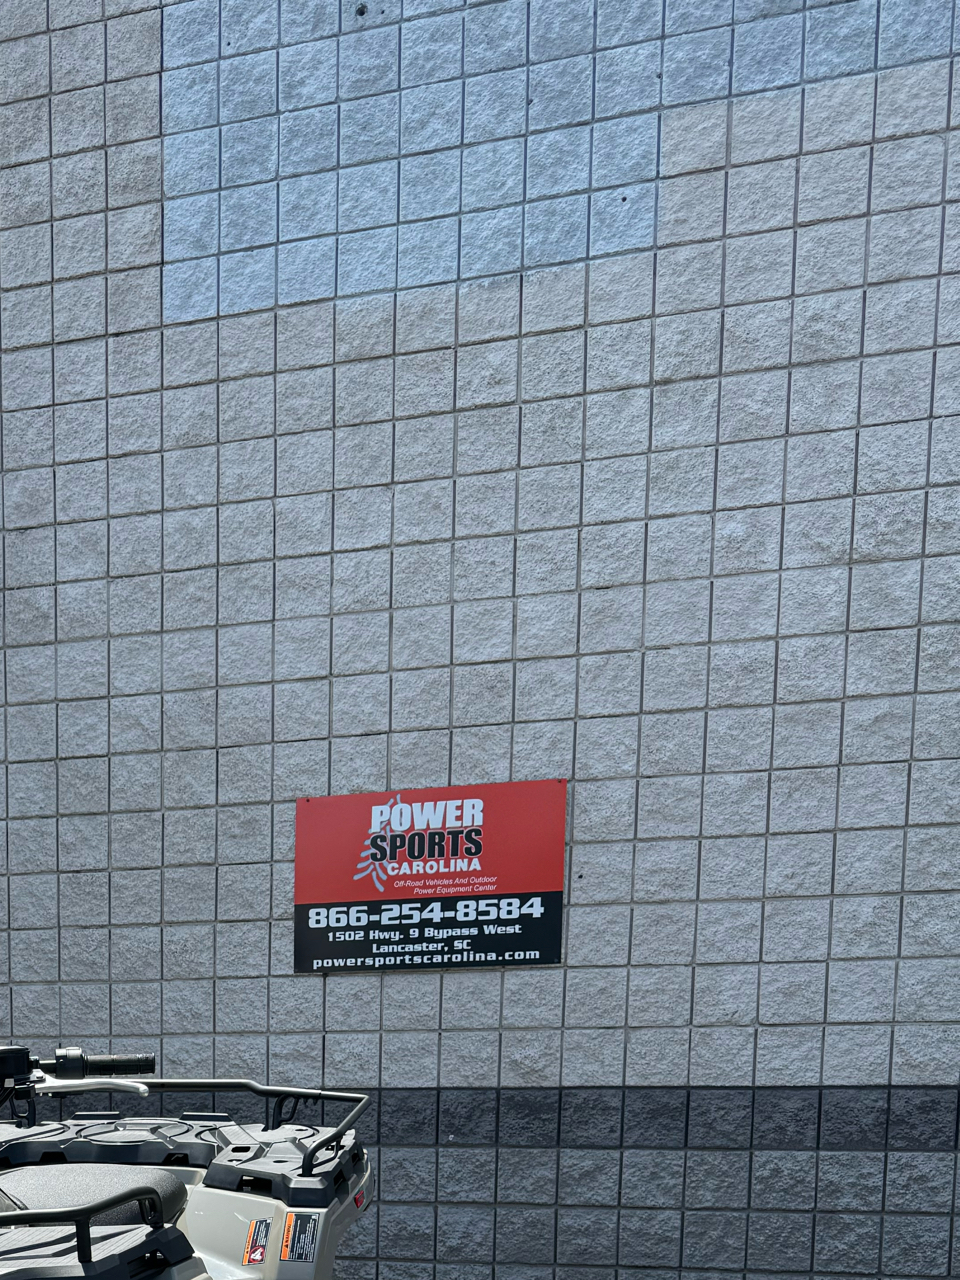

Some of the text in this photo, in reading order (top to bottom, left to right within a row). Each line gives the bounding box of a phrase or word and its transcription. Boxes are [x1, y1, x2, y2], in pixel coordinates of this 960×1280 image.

[371, 798, 484, 833] POWER
[369, 827, 483, 862] SPORTS
[387, 858, 481, 876] CAROLINA
[393, 879, 423, 888] Off-Road
[425, 877, 453, 886] Vehicles
[469, 876, 498, 884] Outdoor
[413, 884, 498, 895] Power Equipment Center
[308, 897, 544, 928] 866-254-8584
[328, 924, 522, 941] 1502 Hwy. 9 Bypass West
[372, 939, 471, 953] Lancaster, SC
[313, 950, 540, 970] powersportscarolina.com
